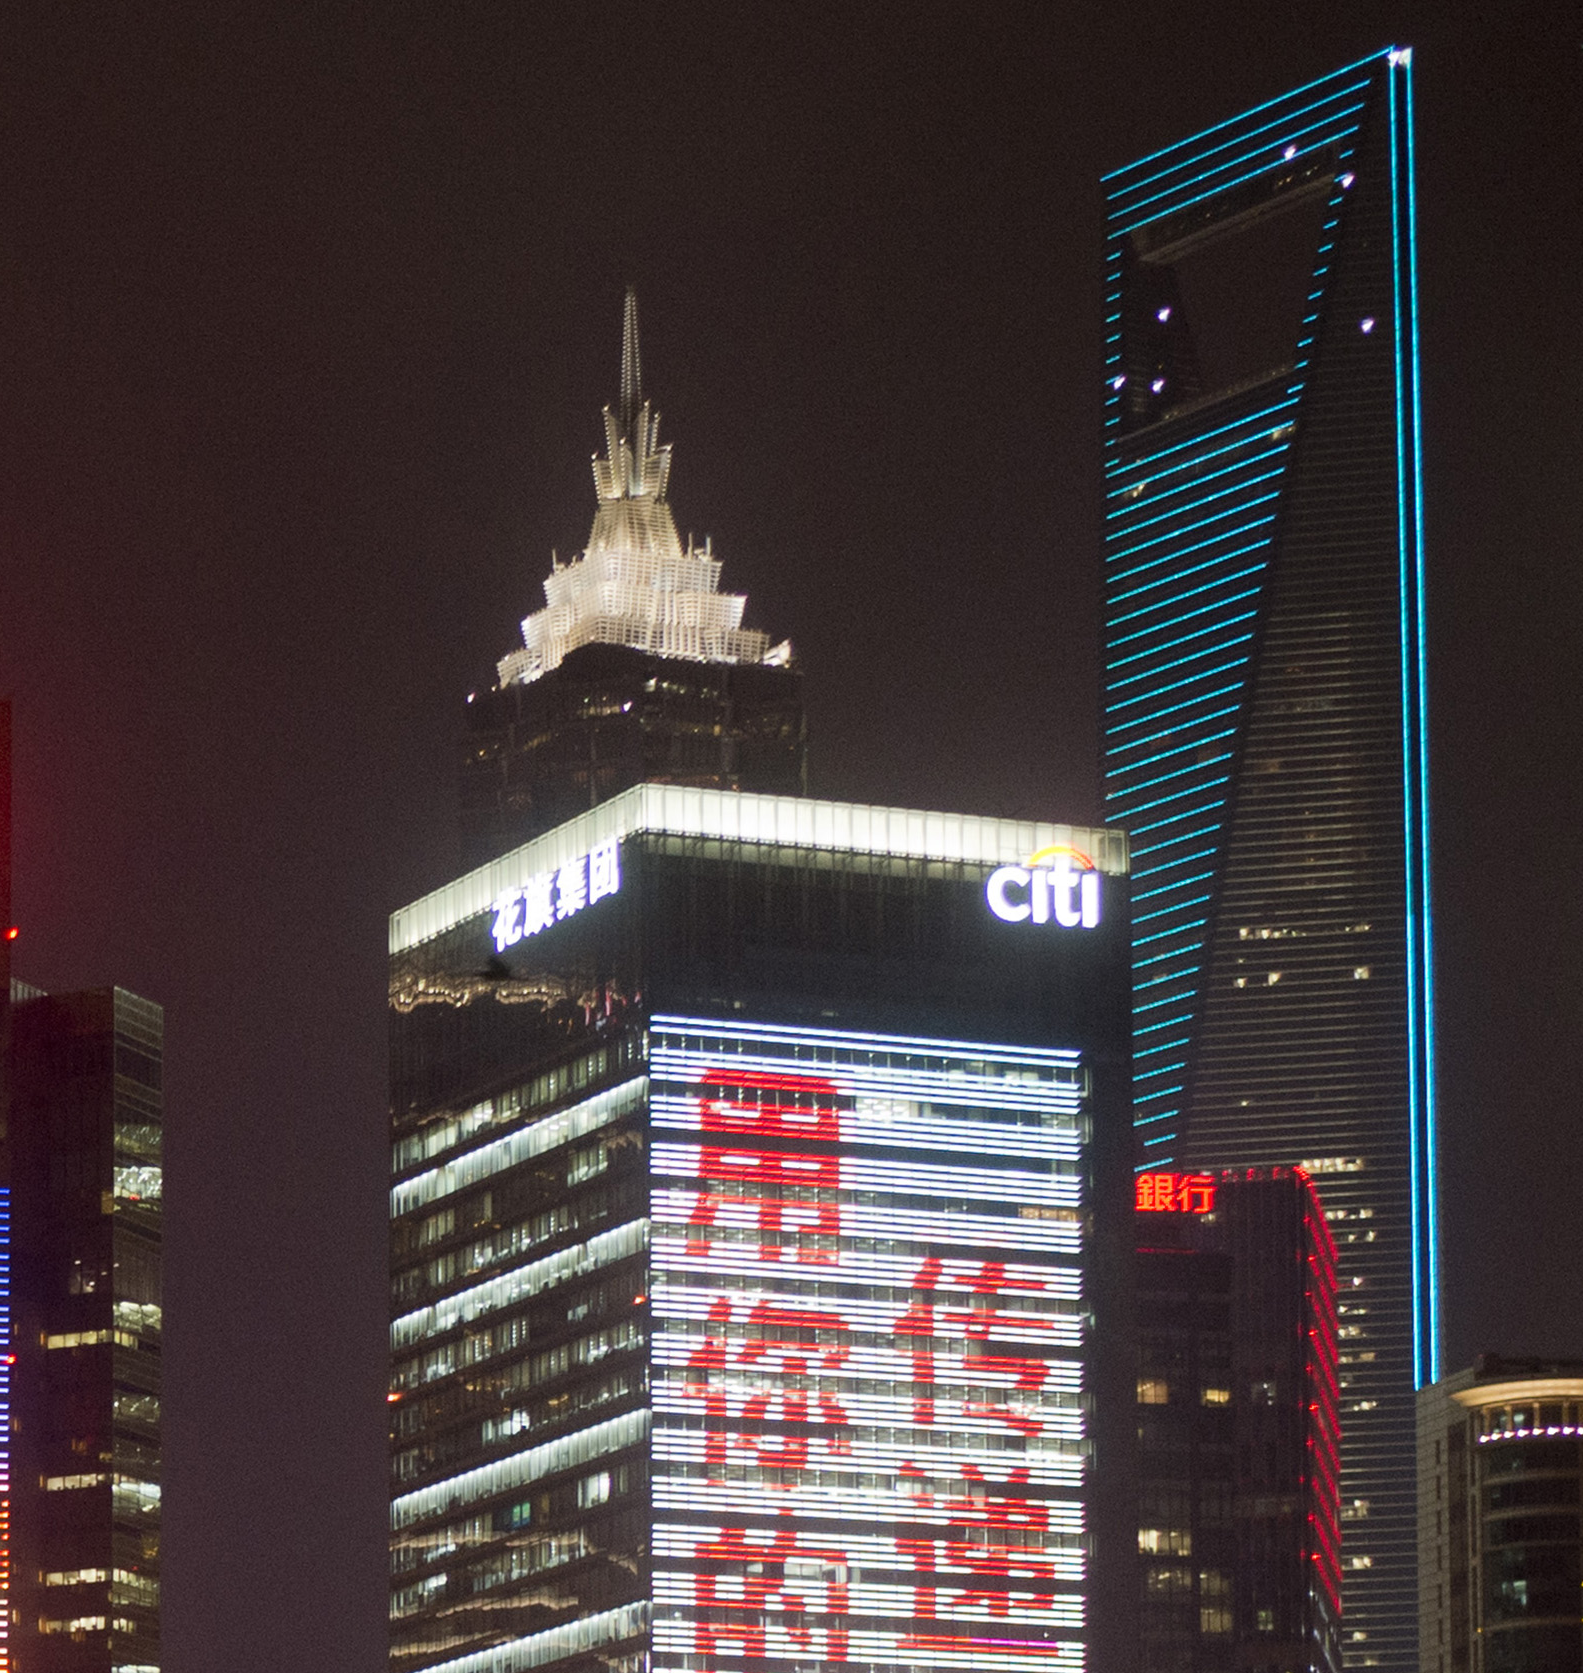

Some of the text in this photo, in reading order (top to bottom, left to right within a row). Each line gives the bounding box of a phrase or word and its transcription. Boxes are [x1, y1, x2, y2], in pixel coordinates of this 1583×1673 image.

[492, 838, 621, 953] 花旗集团
[986, 857, 1101, 929] citi
[1135, 1172, 1217, 1214] 銀行
